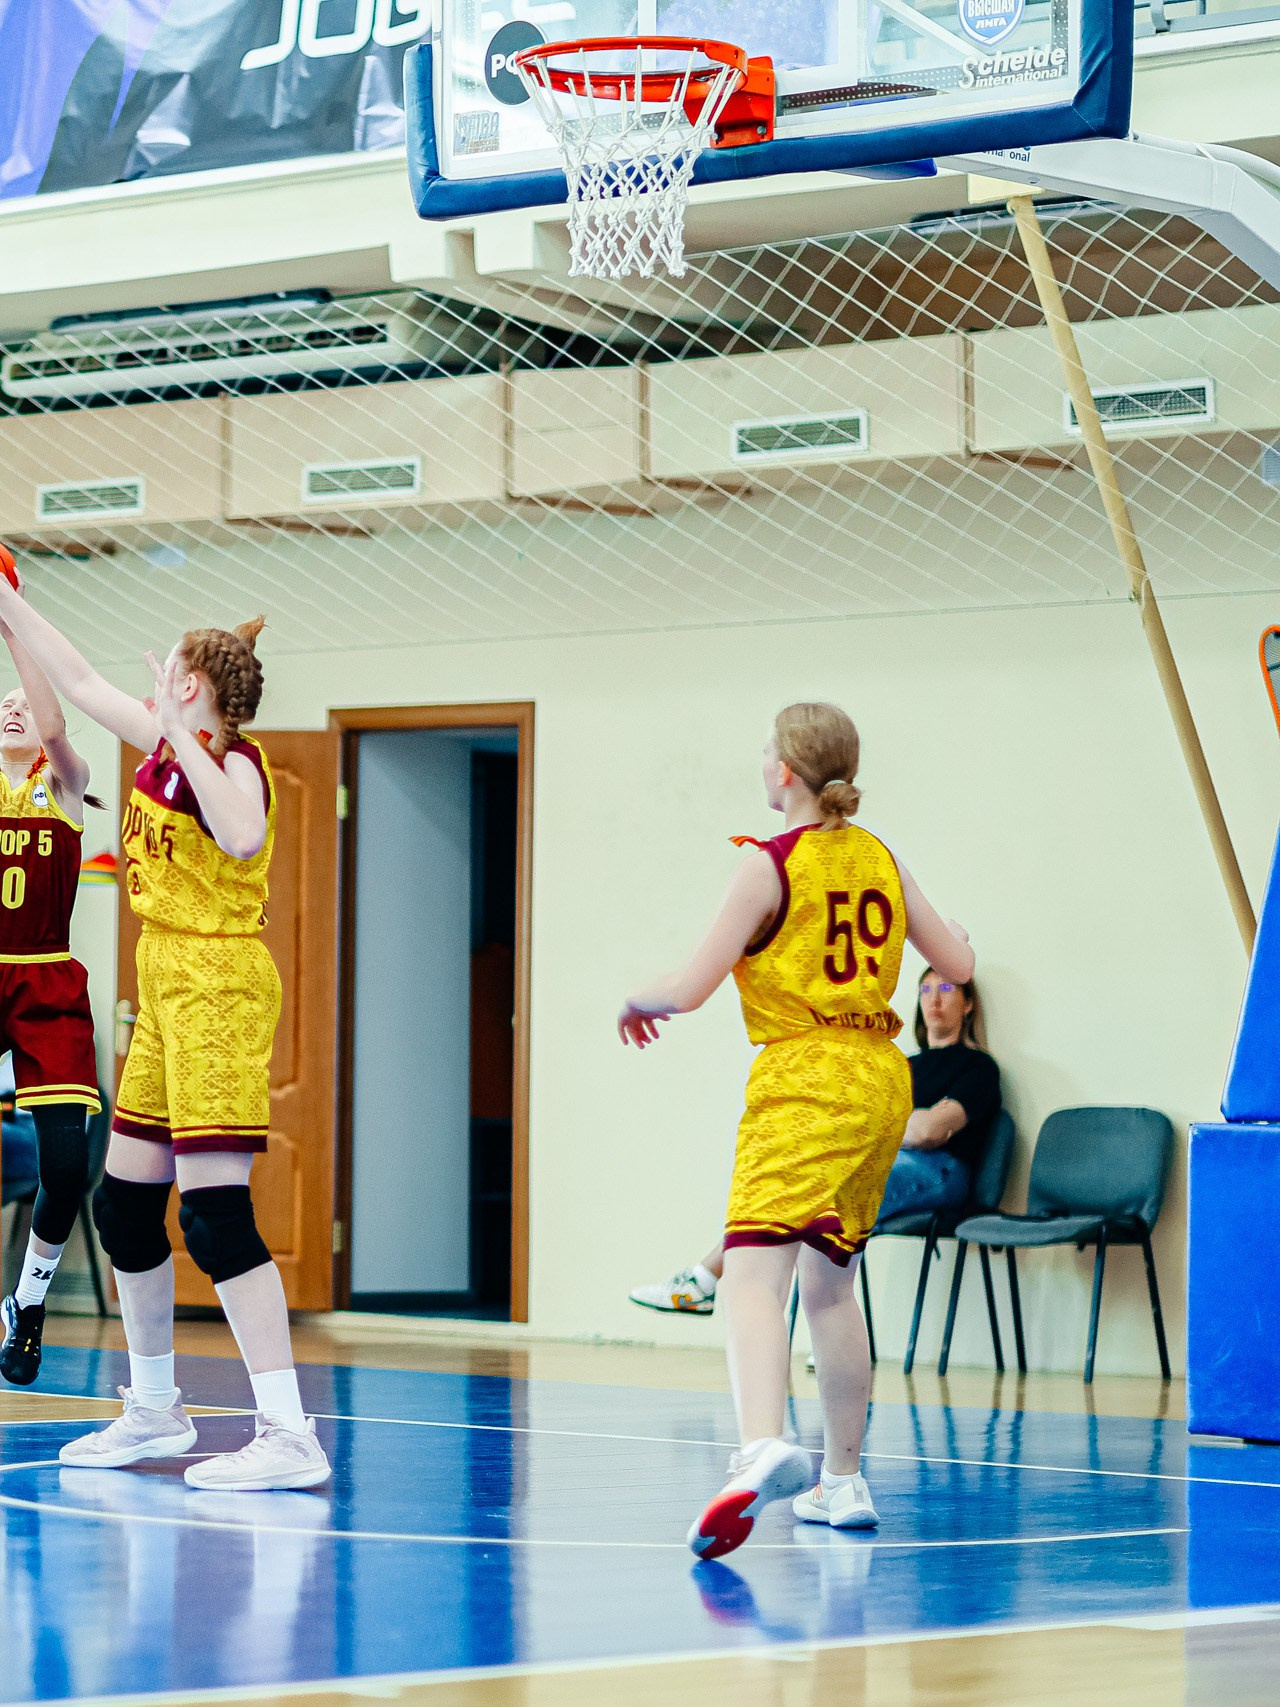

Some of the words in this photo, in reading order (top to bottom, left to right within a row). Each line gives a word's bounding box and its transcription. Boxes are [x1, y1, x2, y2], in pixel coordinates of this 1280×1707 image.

[959, 44, 1067, 90] Schelde
[975, 66, 1062, 89] international
[37, 829, 53, 857] 5
[823, 887, 893, 986] 59
